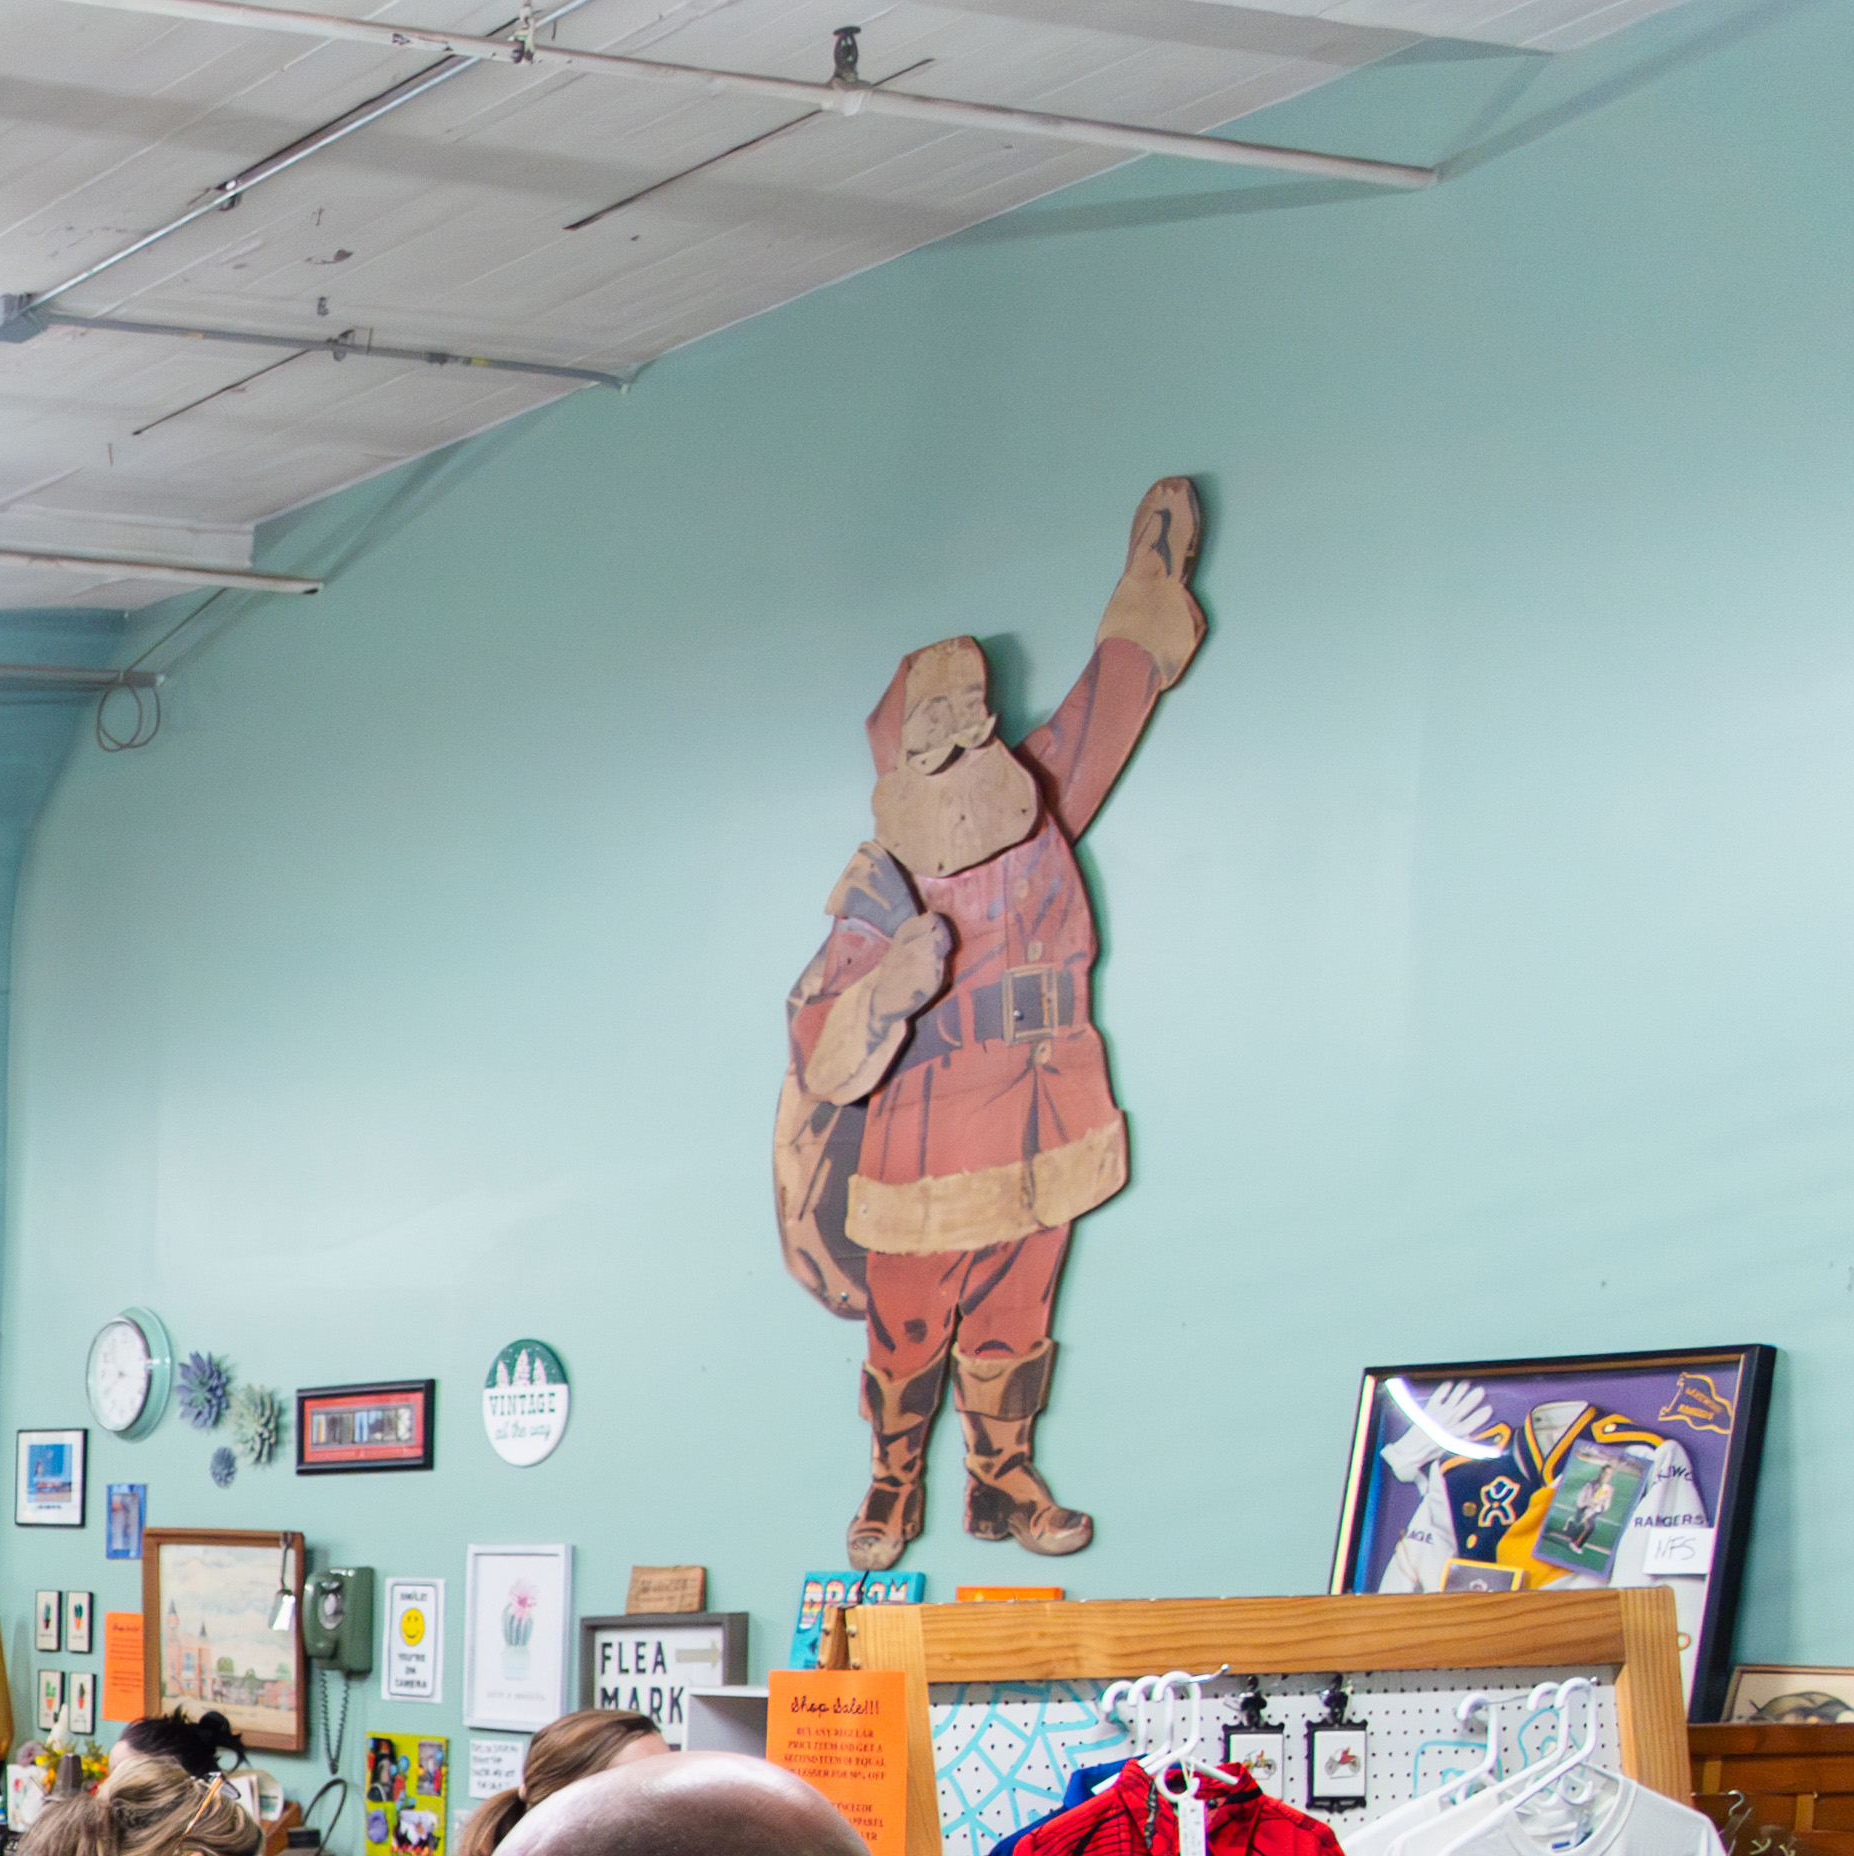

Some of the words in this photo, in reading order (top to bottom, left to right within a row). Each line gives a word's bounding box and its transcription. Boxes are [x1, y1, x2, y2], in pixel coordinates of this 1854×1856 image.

[489, 1392, 556, 1416] VINTAGE
[1634, 1513, 1706, 1529] RANGERS
[1654, 1535, 1697, 1561] NFS
[600, 1641, 667, 1675] FLEA
[600, 1686, 685, 1725] MARK
[791, 1695, 829, 1718] Shop
